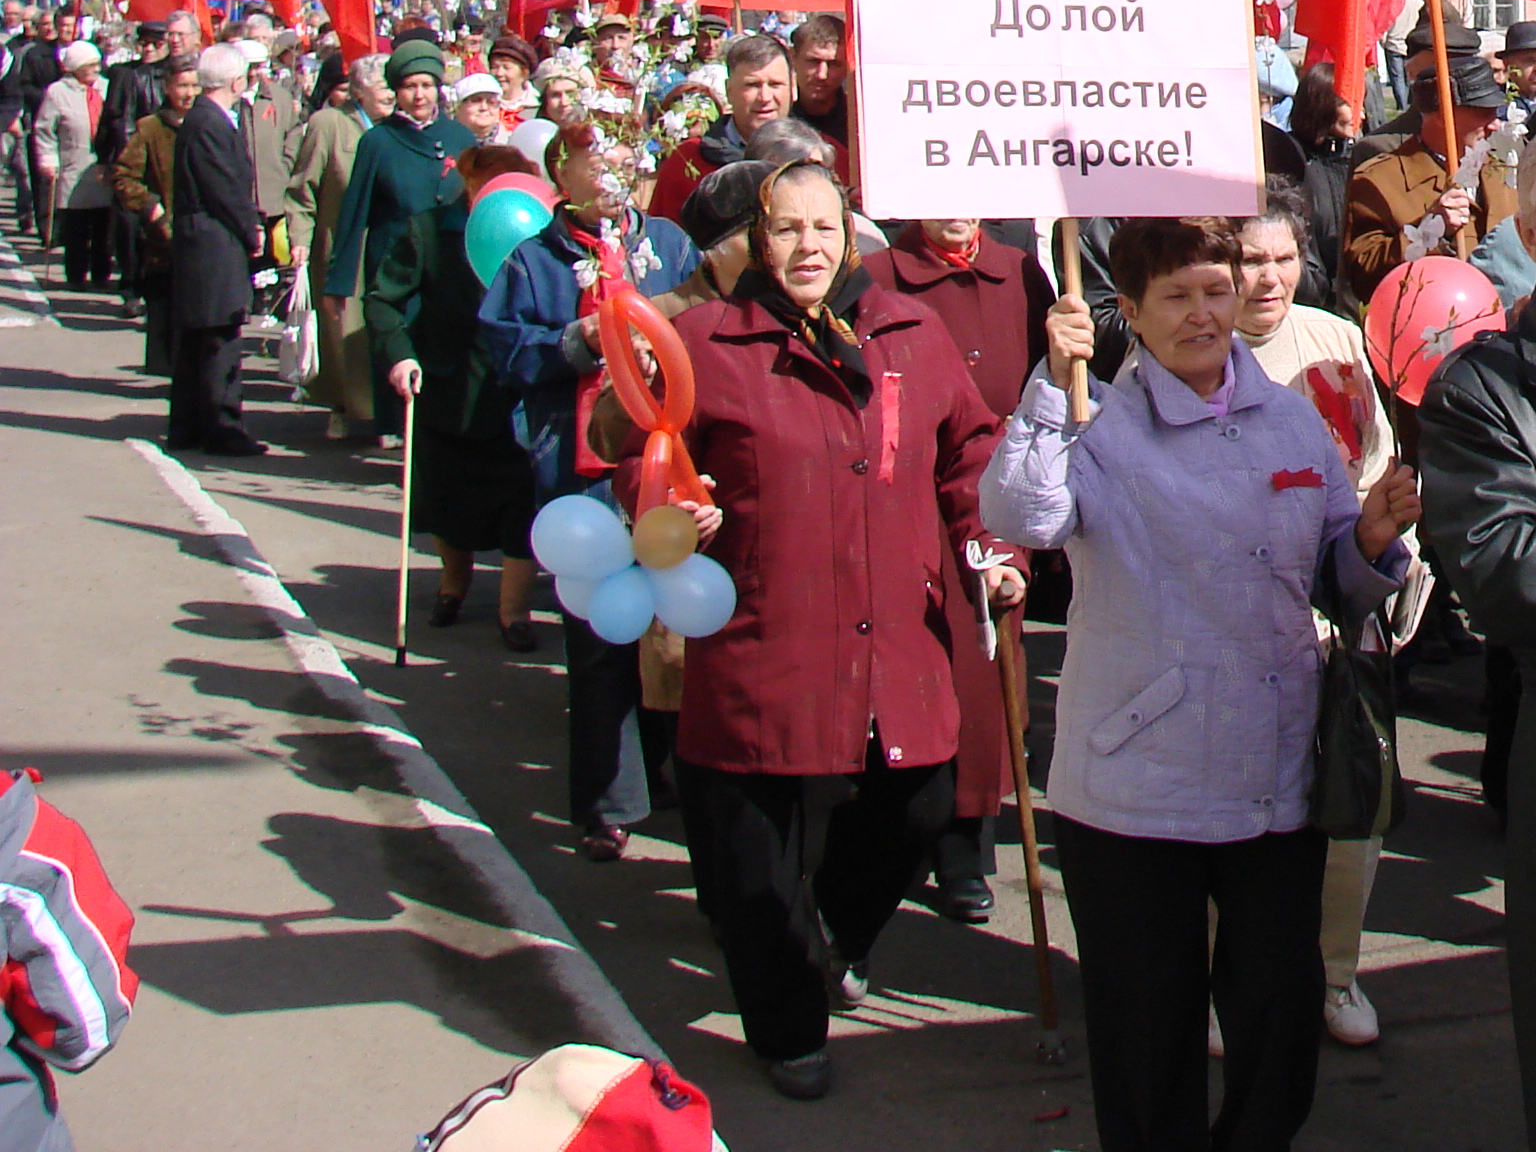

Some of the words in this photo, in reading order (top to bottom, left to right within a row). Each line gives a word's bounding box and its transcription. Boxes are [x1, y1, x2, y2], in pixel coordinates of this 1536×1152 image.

[902, 78, 1208, 113] двоевластие
[924, 139, 951, 167] в
[967, 129, 1194, 176] Ангарске!
